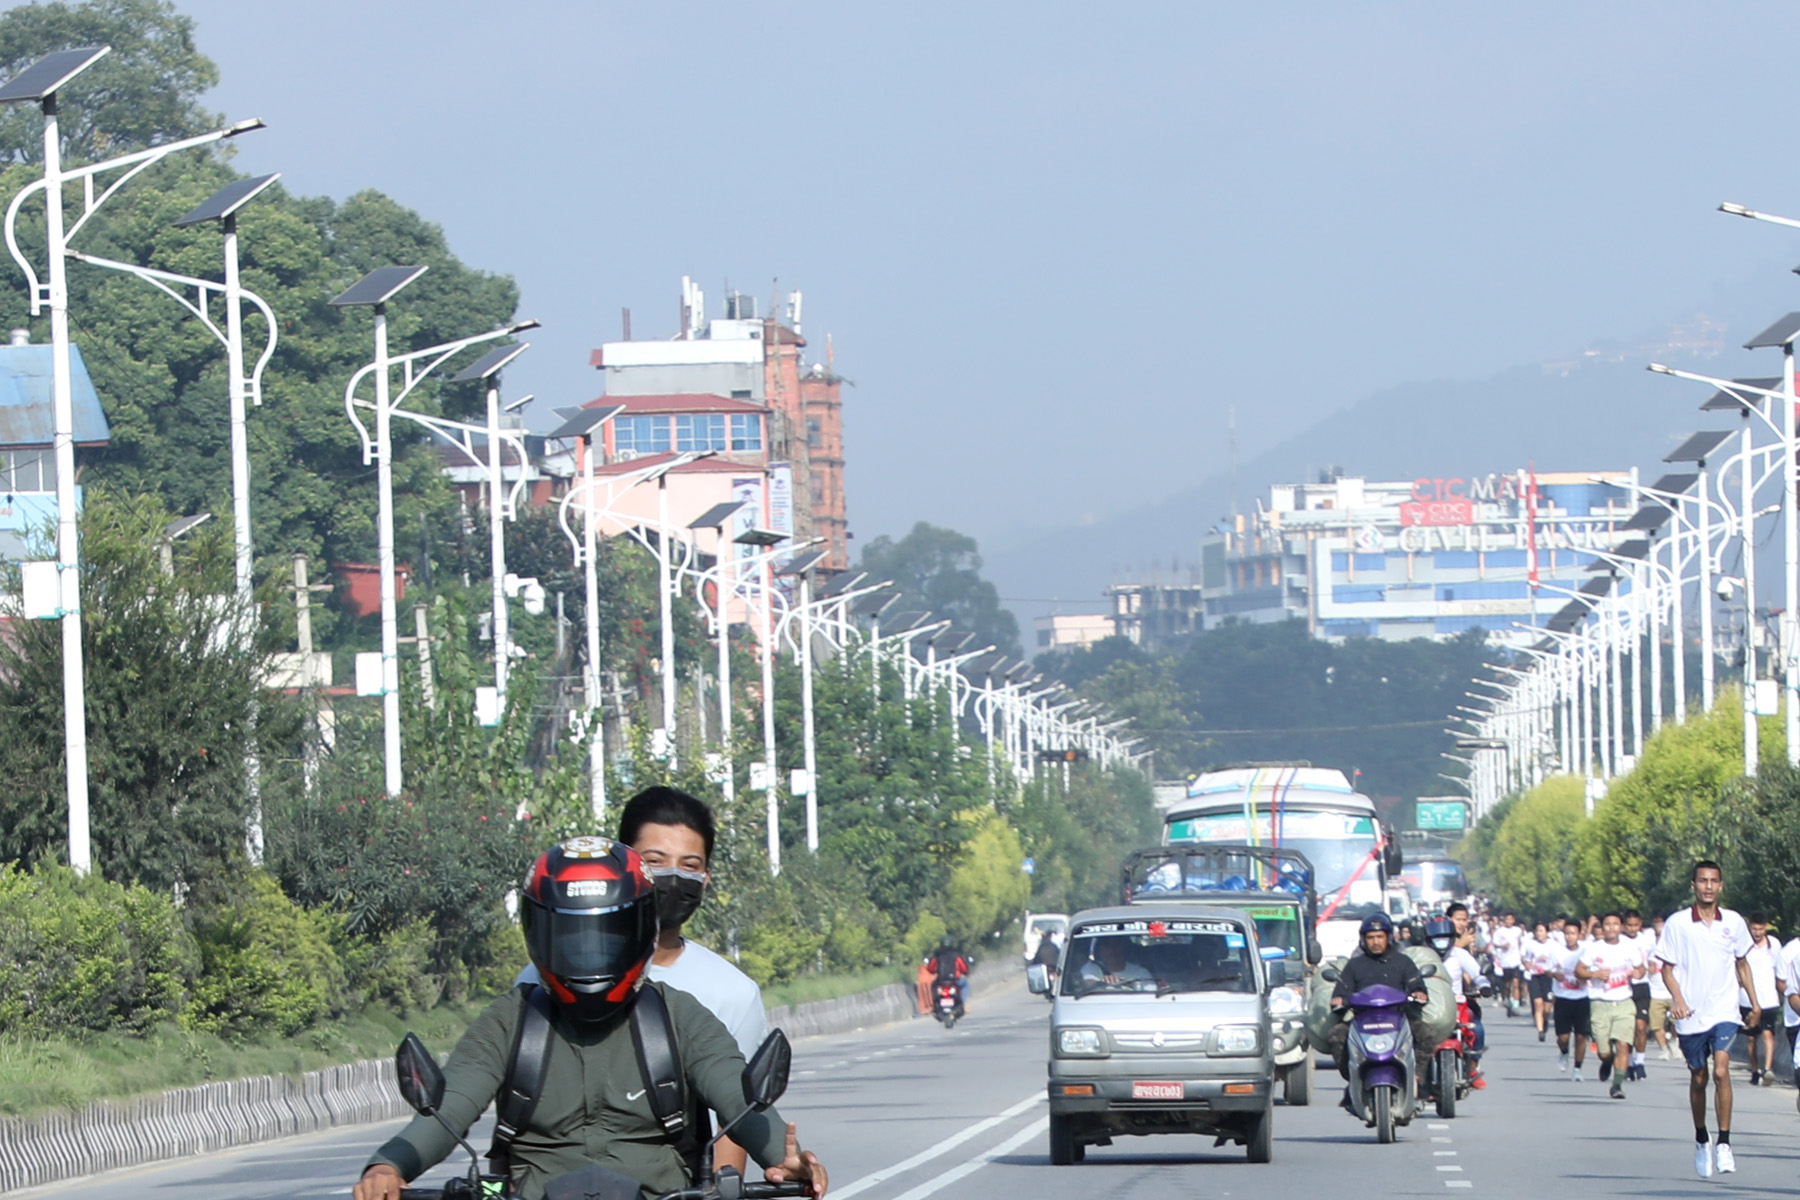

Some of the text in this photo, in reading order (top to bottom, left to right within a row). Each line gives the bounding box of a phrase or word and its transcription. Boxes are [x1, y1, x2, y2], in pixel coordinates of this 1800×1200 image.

[1411, 474, 1544, 501] CTC MAL
[1401, 525, 1499, 551] CIVIL
